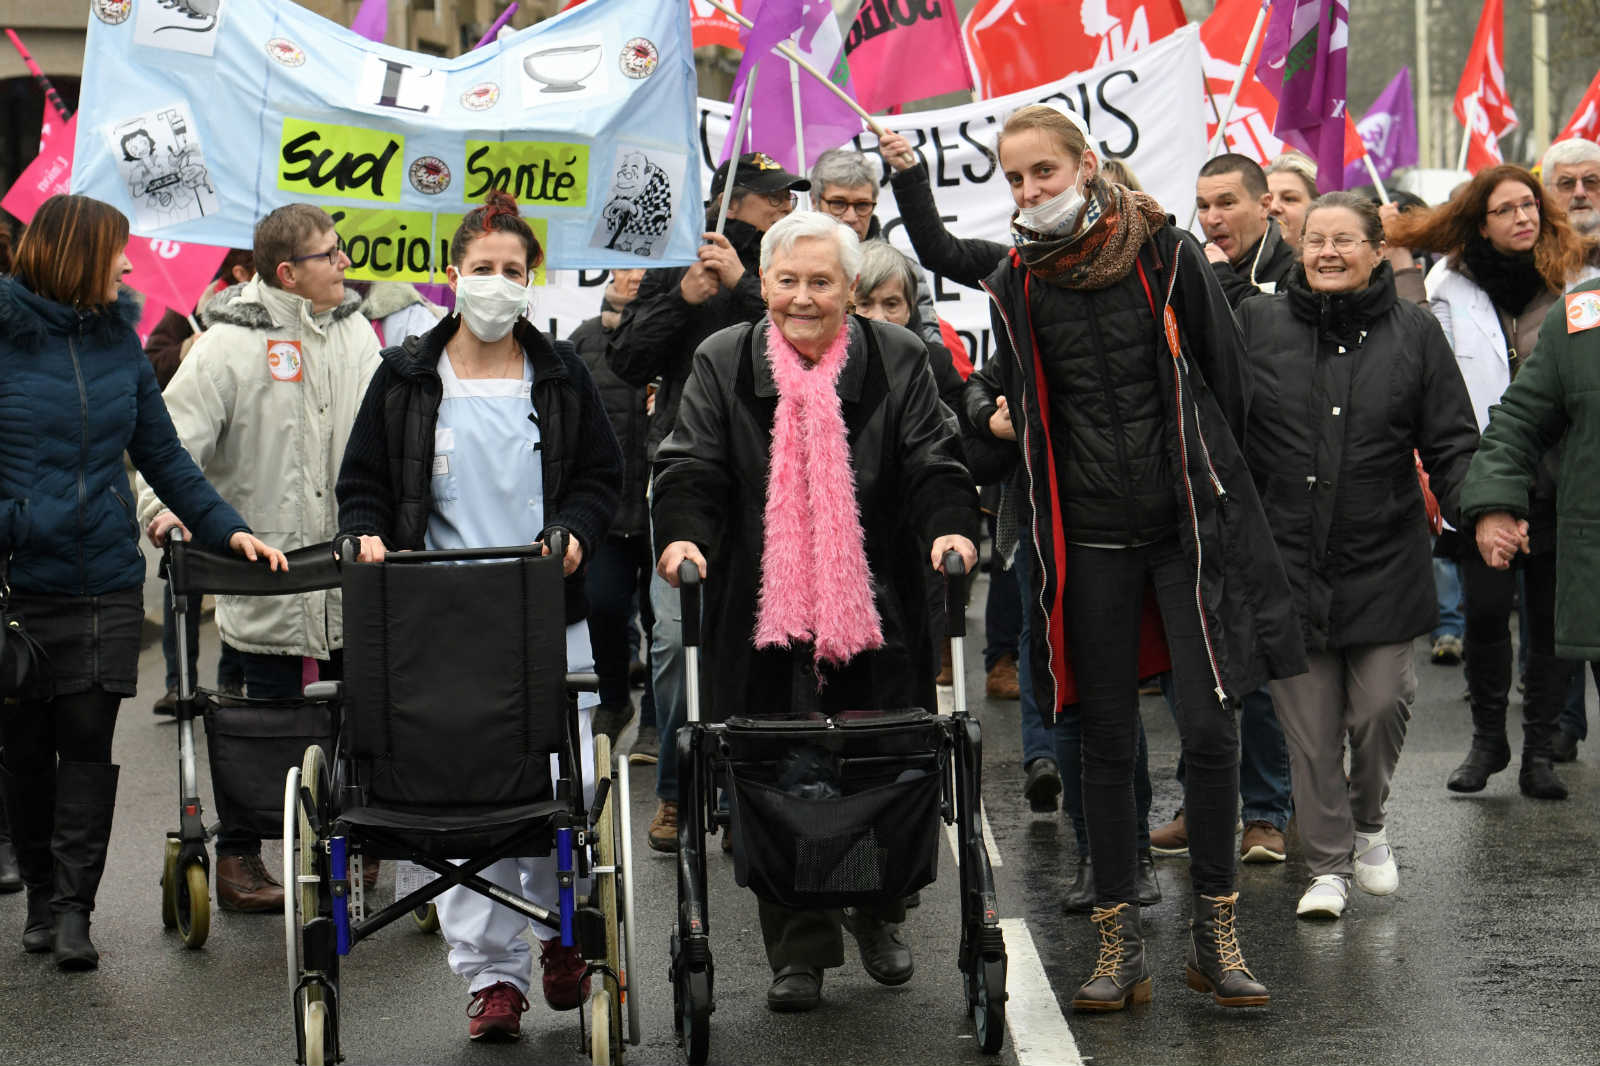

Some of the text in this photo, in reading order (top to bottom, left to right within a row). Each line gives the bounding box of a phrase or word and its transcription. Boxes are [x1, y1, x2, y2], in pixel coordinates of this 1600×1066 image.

[282, 130, 400, 197] Sud
[467, 146, 577, 202] Santé
[331, 211, 450, 273] ocia
